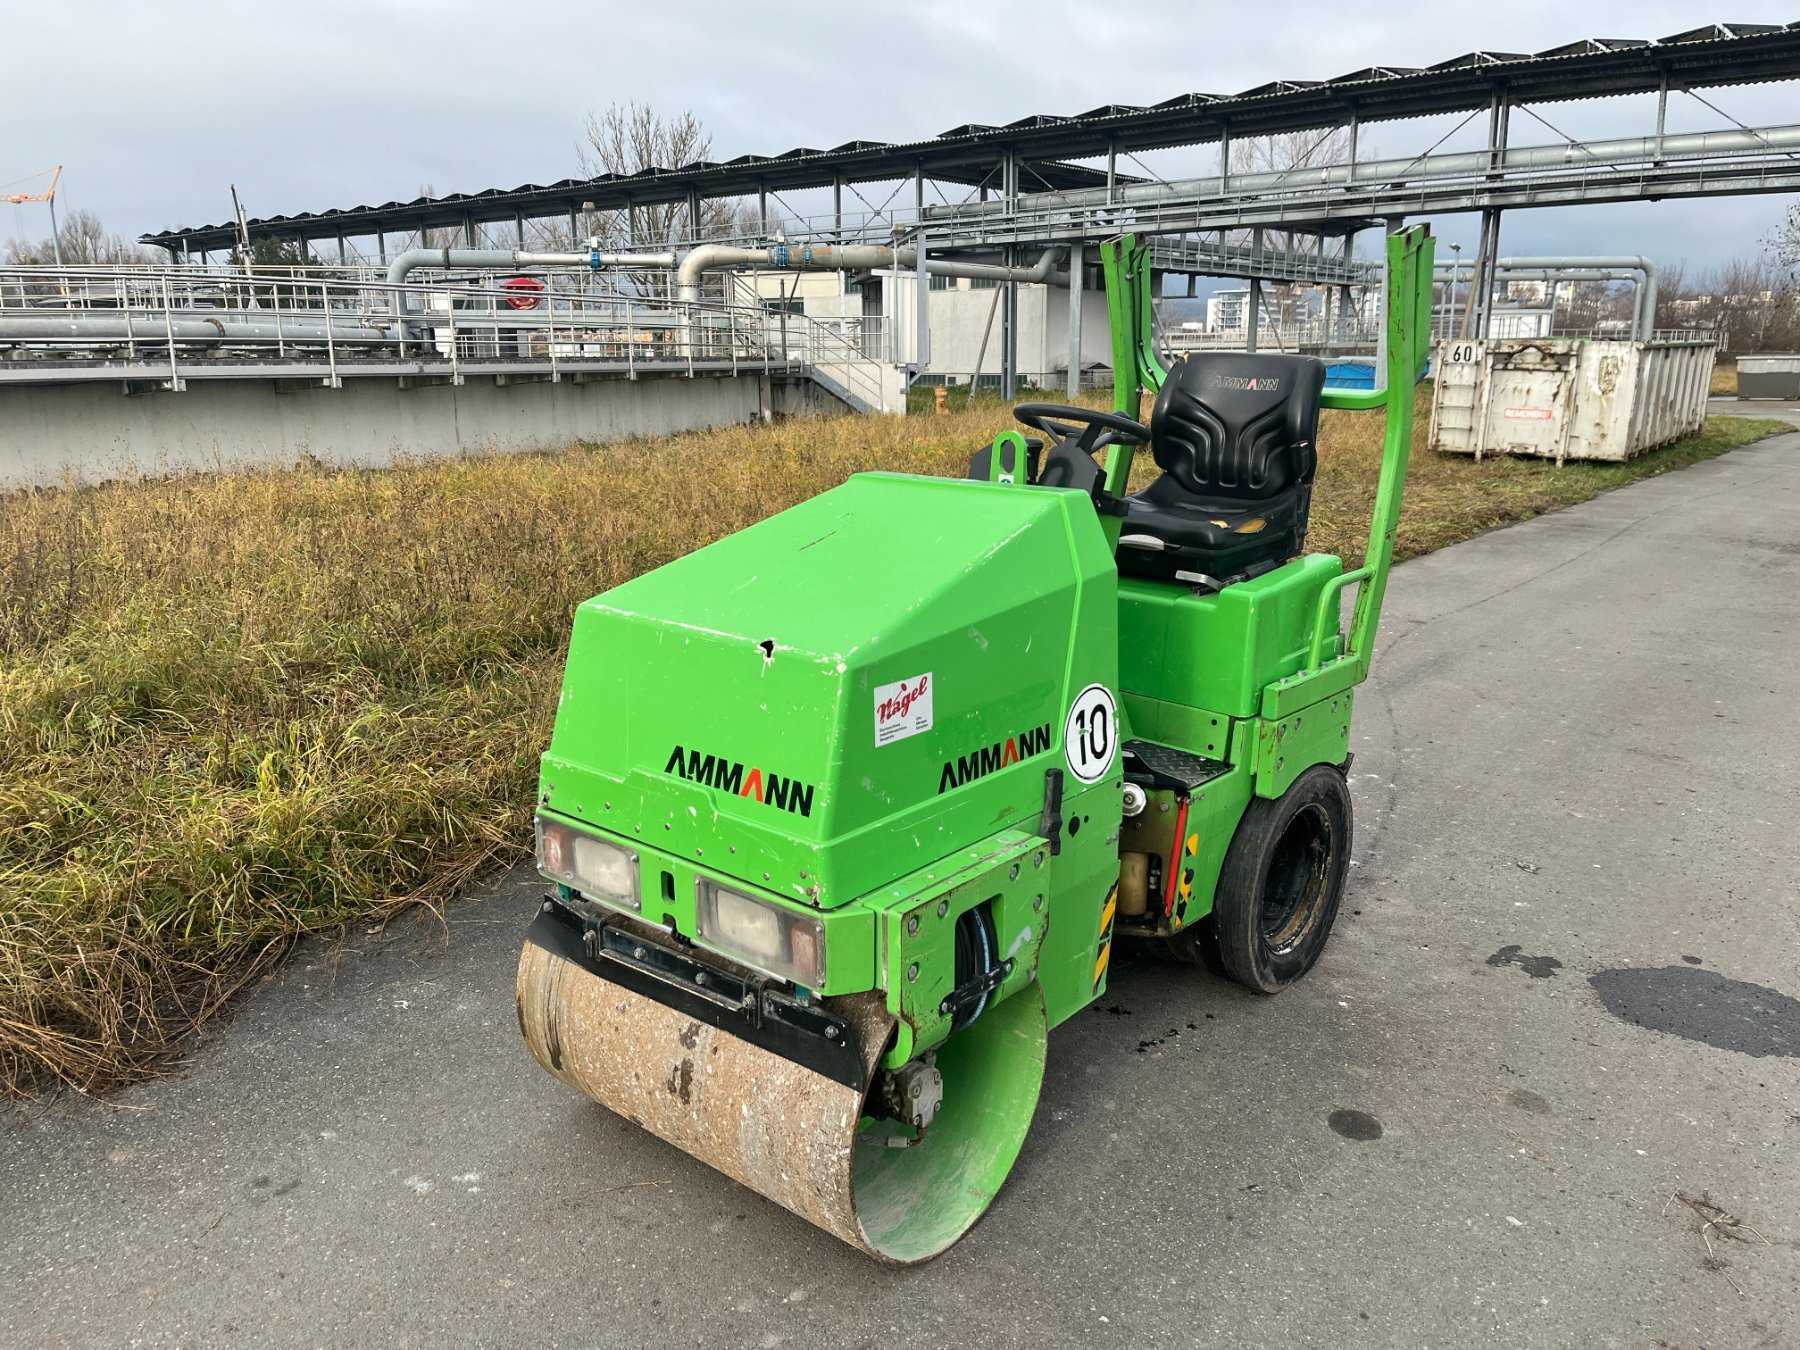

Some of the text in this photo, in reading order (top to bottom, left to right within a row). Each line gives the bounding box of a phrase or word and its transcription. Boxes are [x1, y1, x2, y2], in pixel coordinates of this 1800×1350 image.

[1453, 345, 1472, 362] 60
[1213, 375, 1280, 391] AMMANN
[877, 676, 928, 724] Nagel
[938, 723, 1050, 794] AMMANN
[1075, 703, 1108, 766] 10
[664, 745, 814, 818] AMMANN
